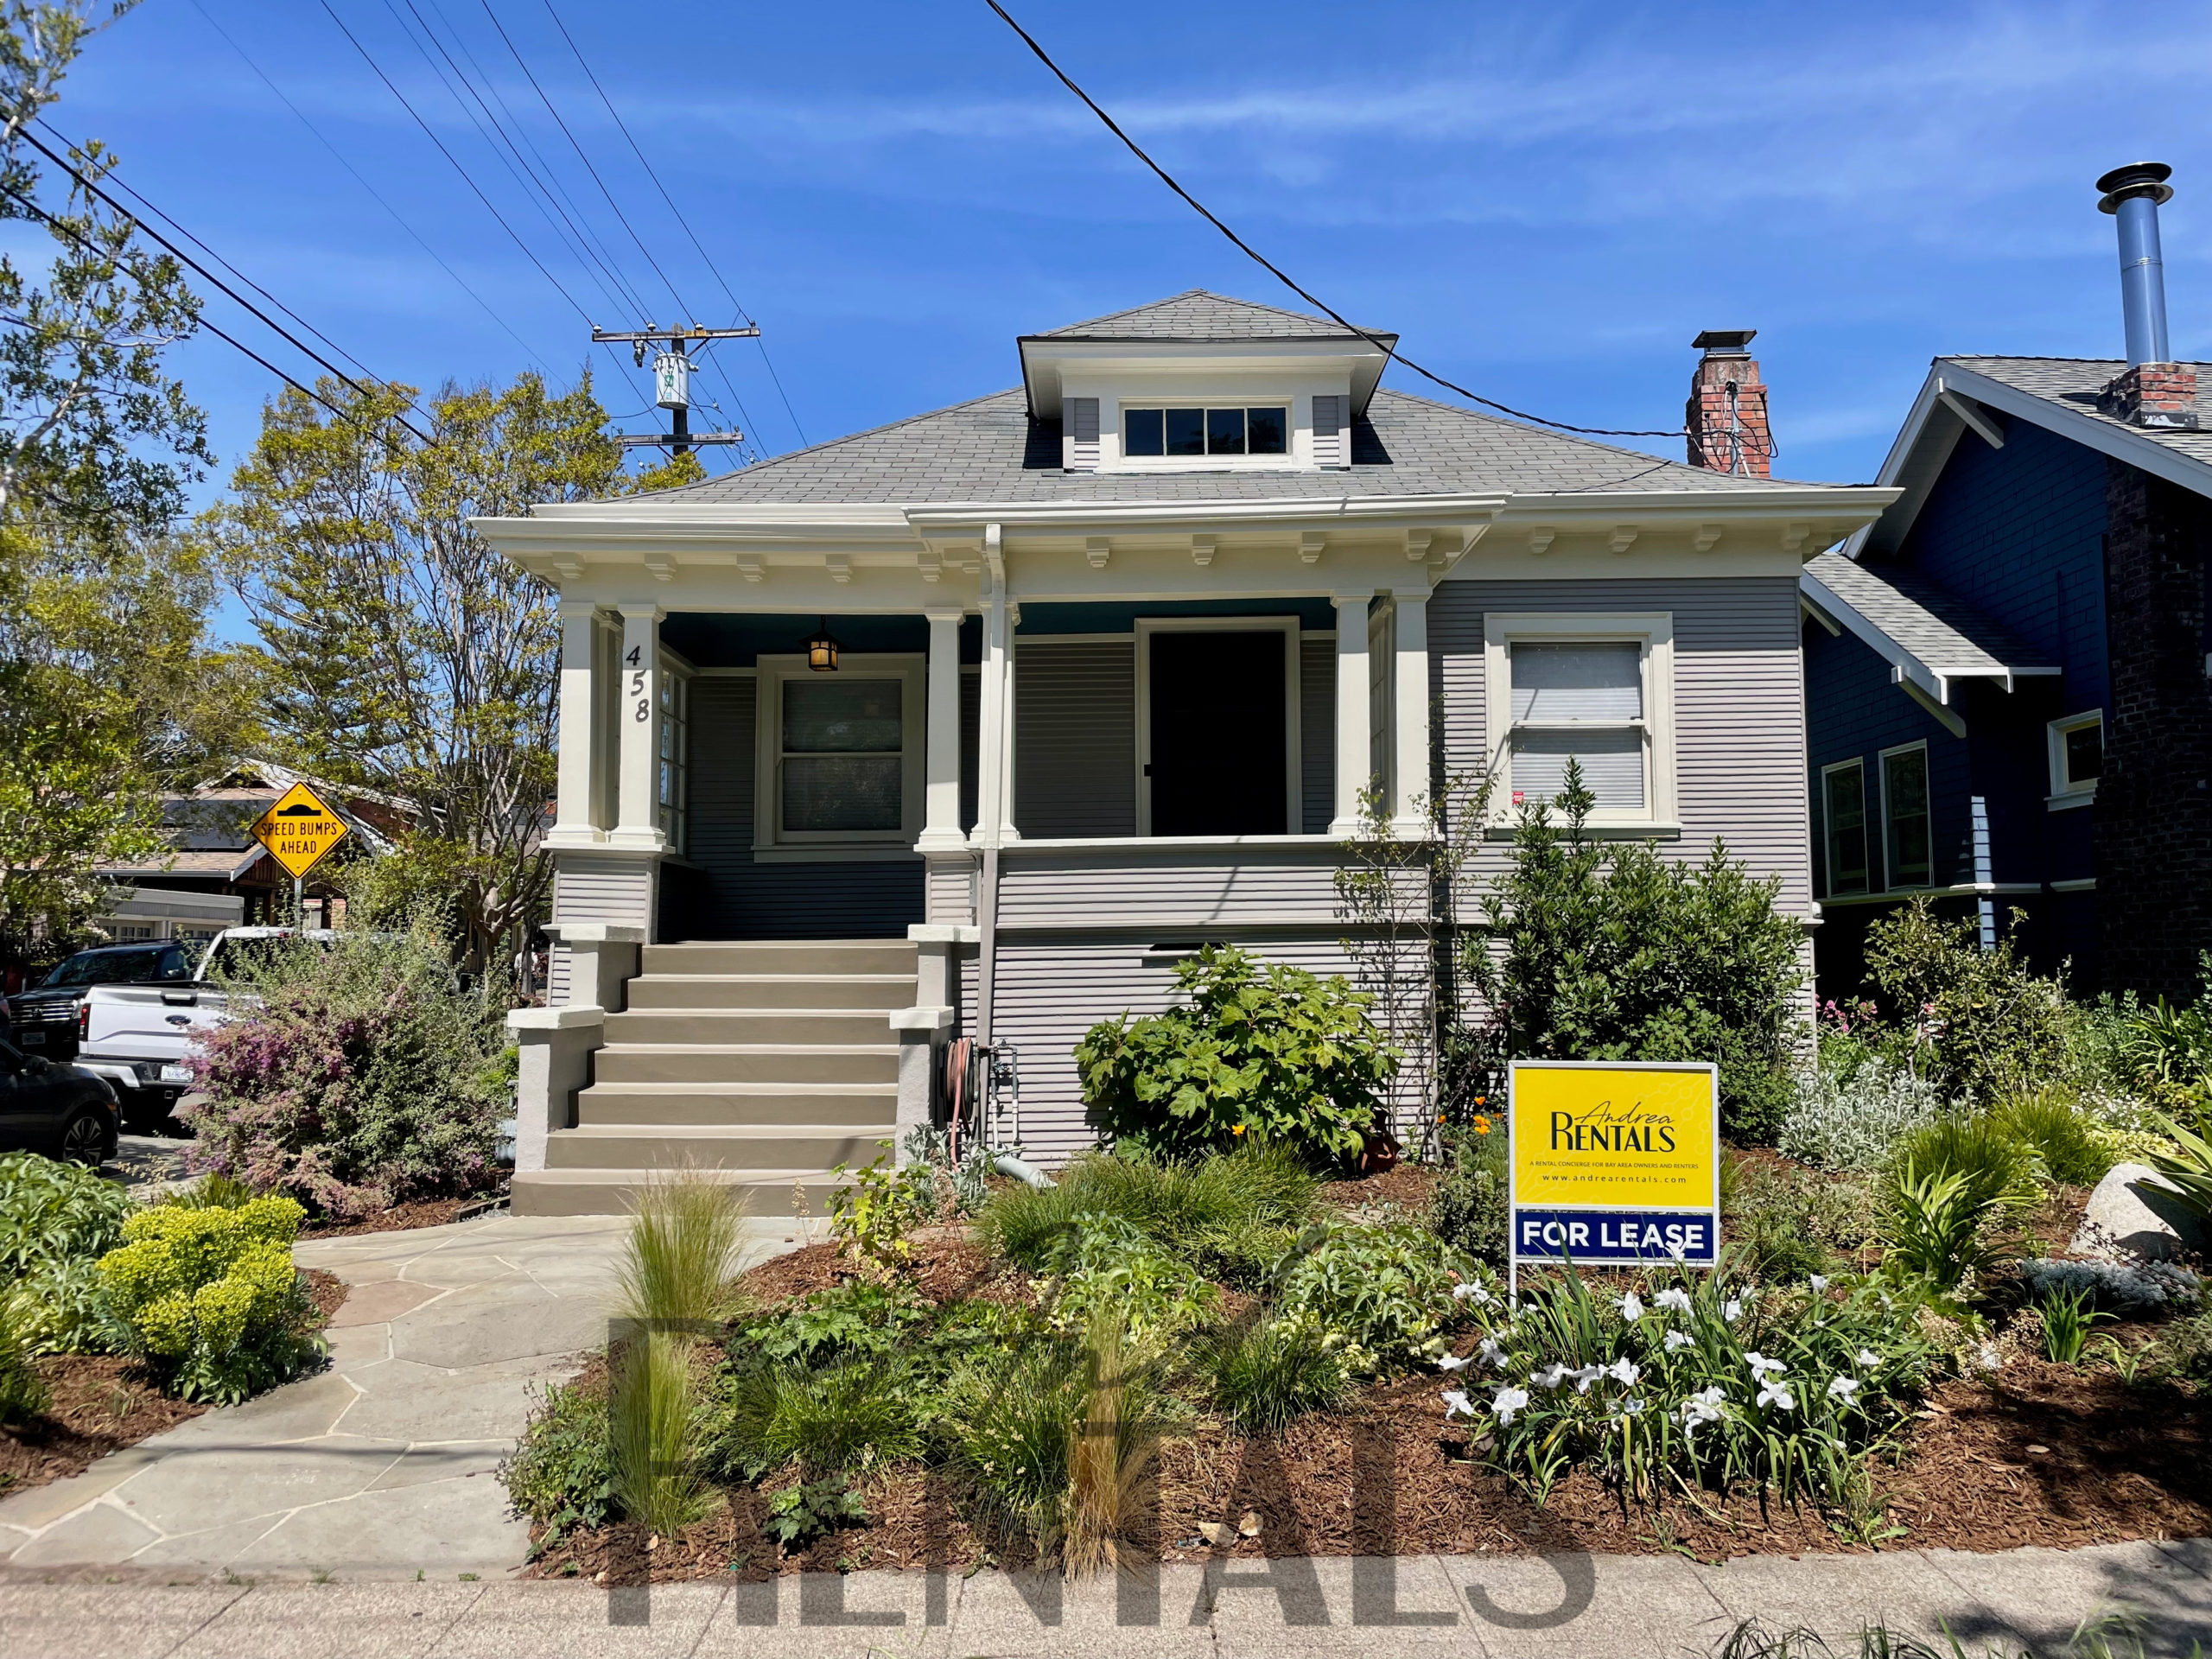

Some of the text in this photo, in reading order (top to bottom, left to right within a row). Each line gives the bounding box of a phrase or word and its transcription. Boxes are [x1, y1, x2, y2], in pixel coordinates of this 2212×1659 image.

[626, 645, 649, 722] 458
[261, 822, 337, 836] SPEED BUMPS
[280, 841, 316, 854] AHEAD
[1574, 1100, 1675, 1124] Andrea
[1542, 1175, 1686, 1184] www.andrearentals.com
[1523, 1221, 1704, 1249] FOR LEASE
